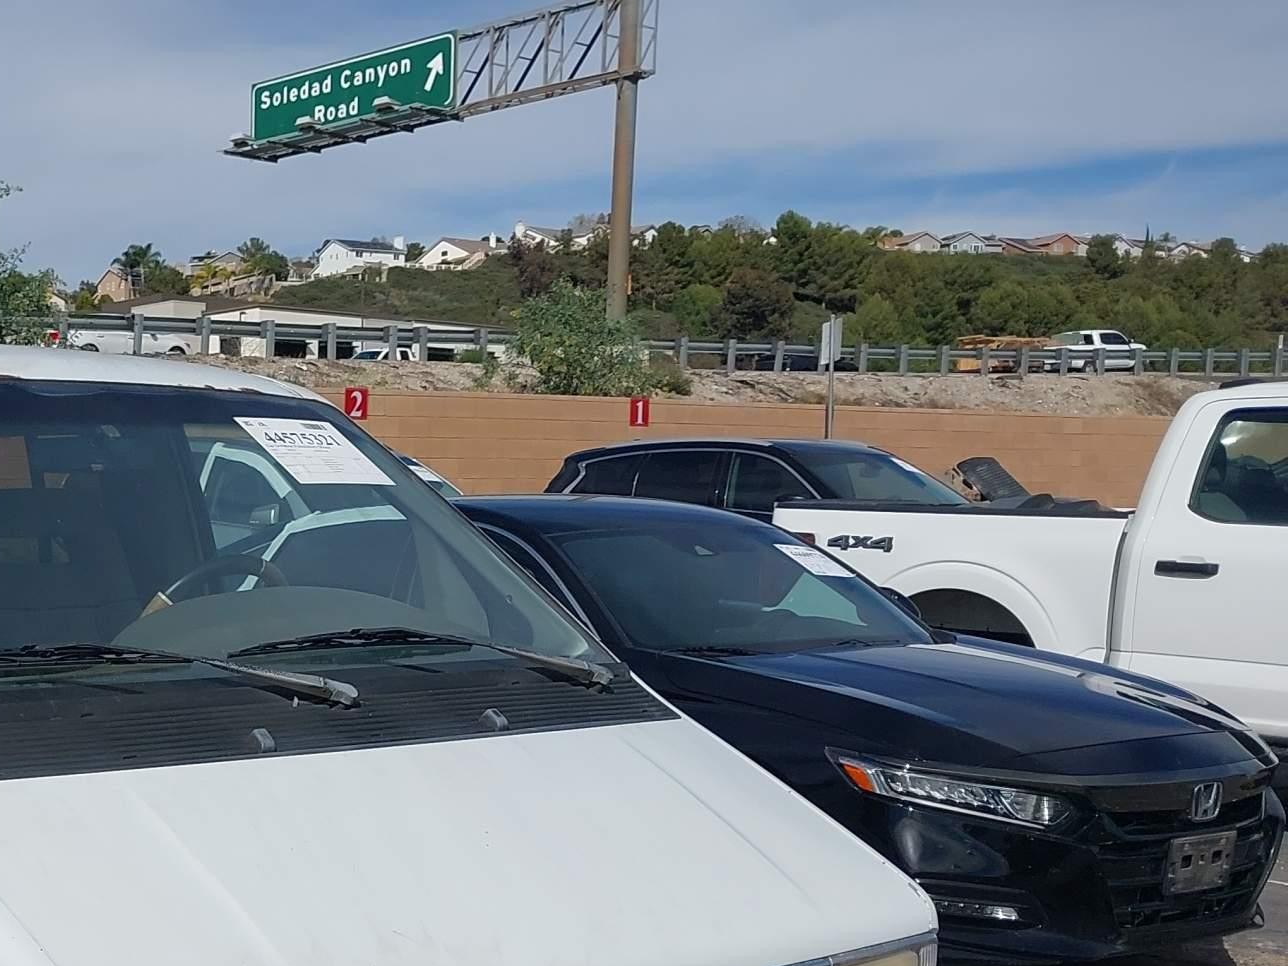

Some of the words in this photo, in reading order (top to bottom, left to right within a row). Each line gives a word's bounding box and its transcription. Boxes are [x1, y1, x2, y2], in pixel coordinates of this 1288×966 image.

[260, 74, 332, 109] Soledad
[340, 58, 411, 89] Canyon
[314, 96, 359, 122] Road
[349, 390, 363, 417] 2
[634, 400, 645, 425] 1
[264, 431, 343, 447] 44575321
